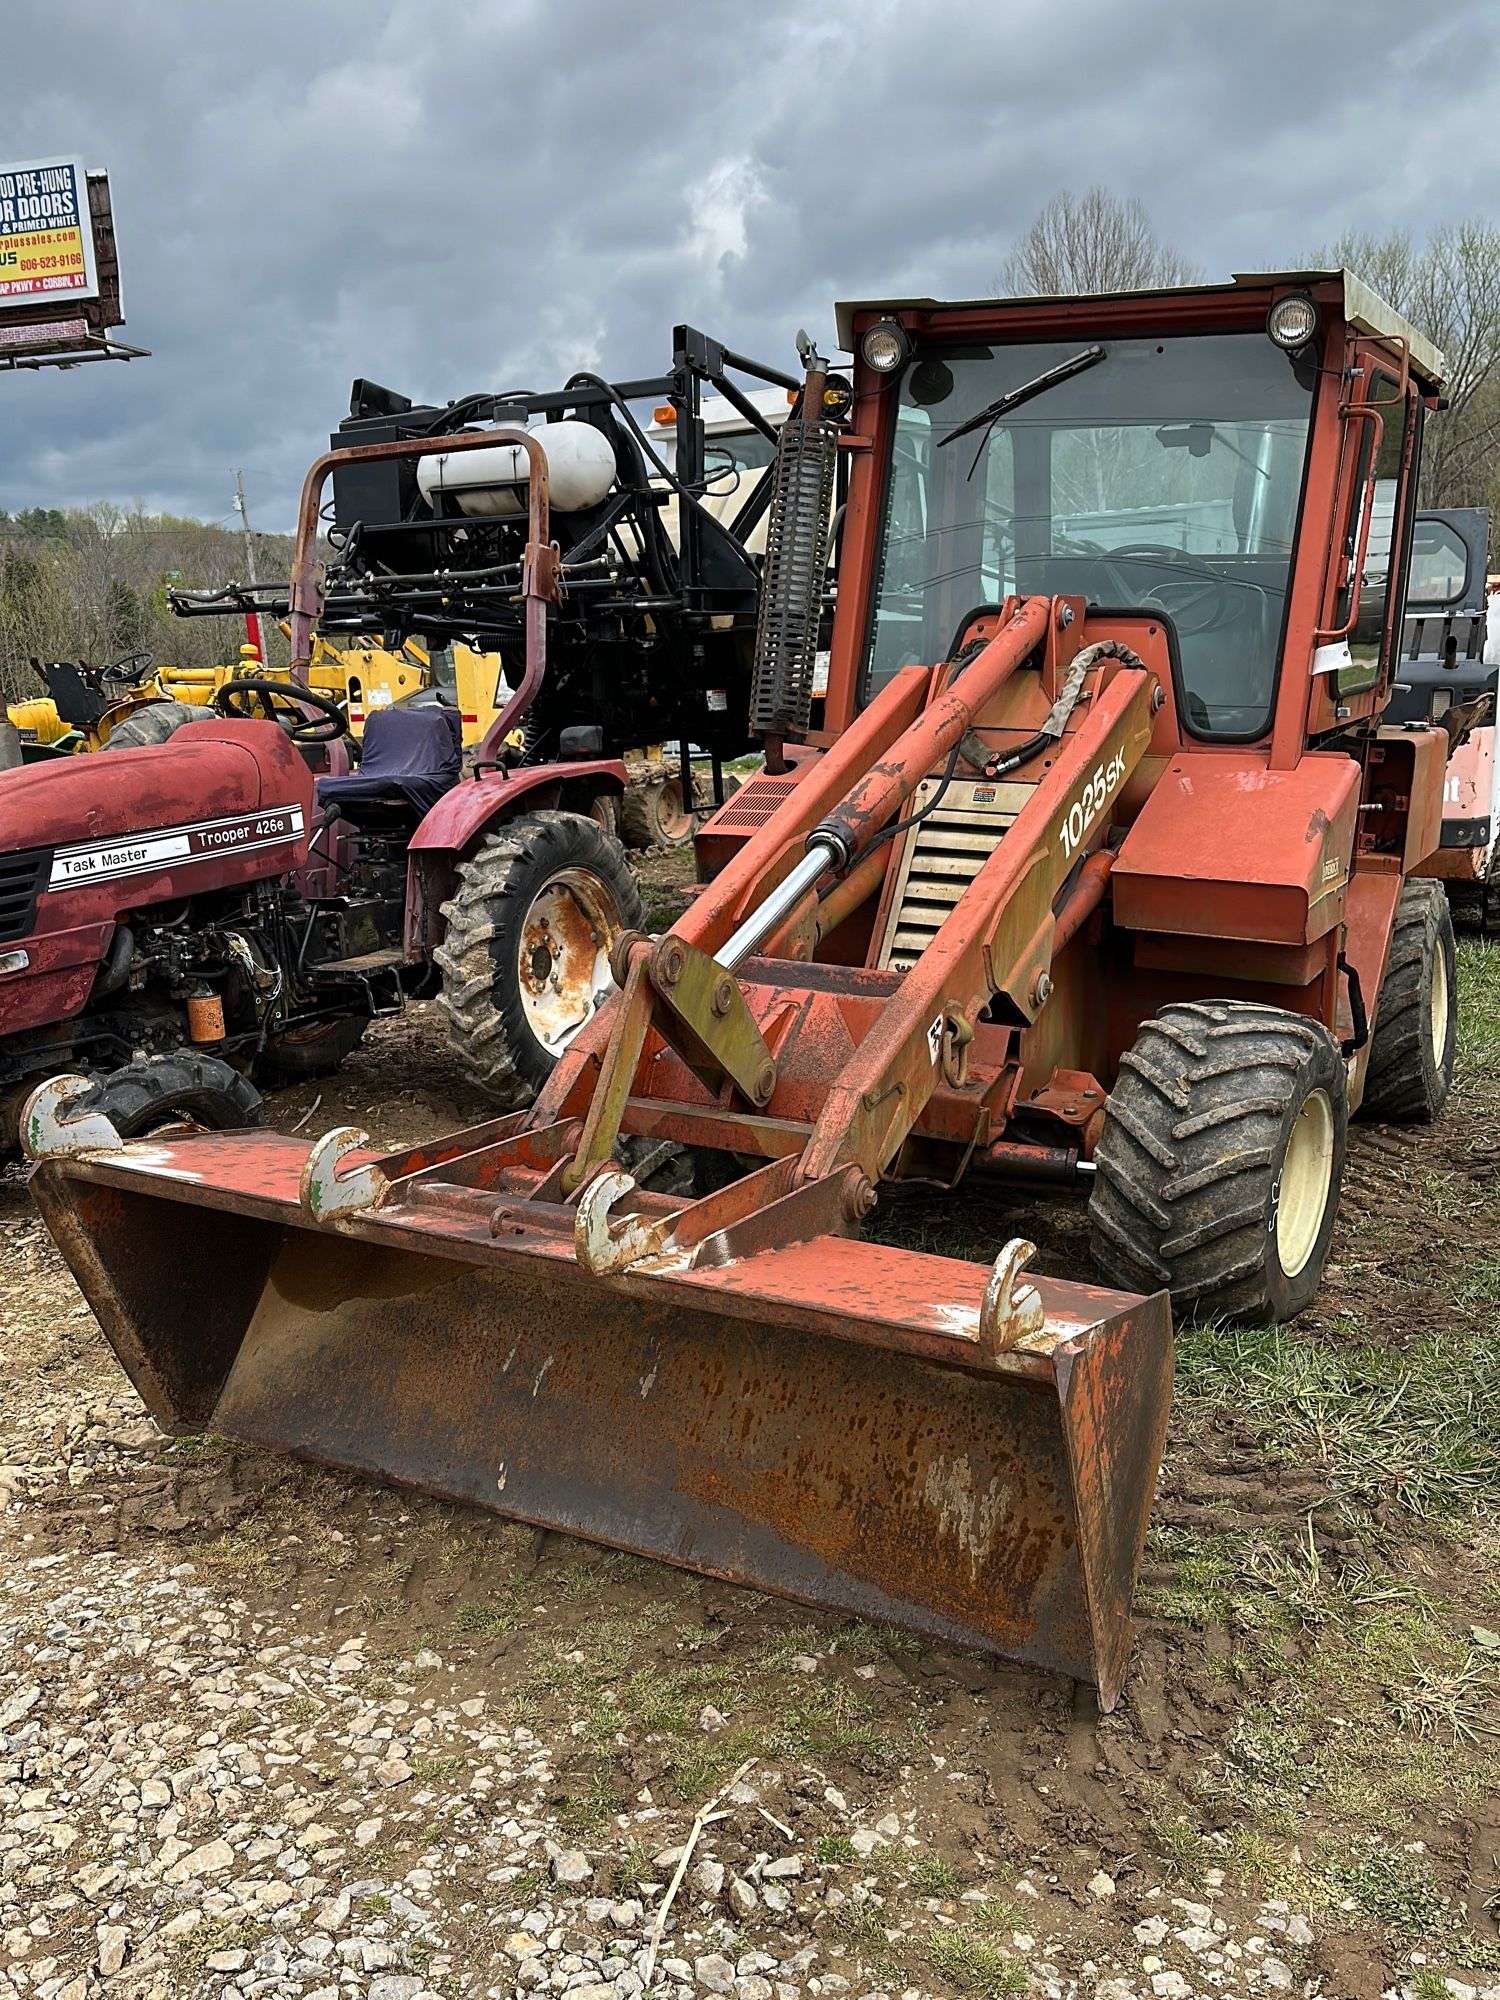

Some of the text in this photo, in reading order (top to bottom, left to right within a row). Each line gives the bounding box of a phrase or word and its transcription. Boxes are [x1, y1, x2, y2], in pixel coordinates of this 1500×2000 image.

[17, 191, 74, 220] DOORS
[2, 214, 77, 234] & PRIMED WHITE
[11, 279, 34, 293] PKWY
[74, 273, 85, 286] KY
[198, 819, 284, 847] Trooper 426e
[62, 849, 148, 874] Task Master
